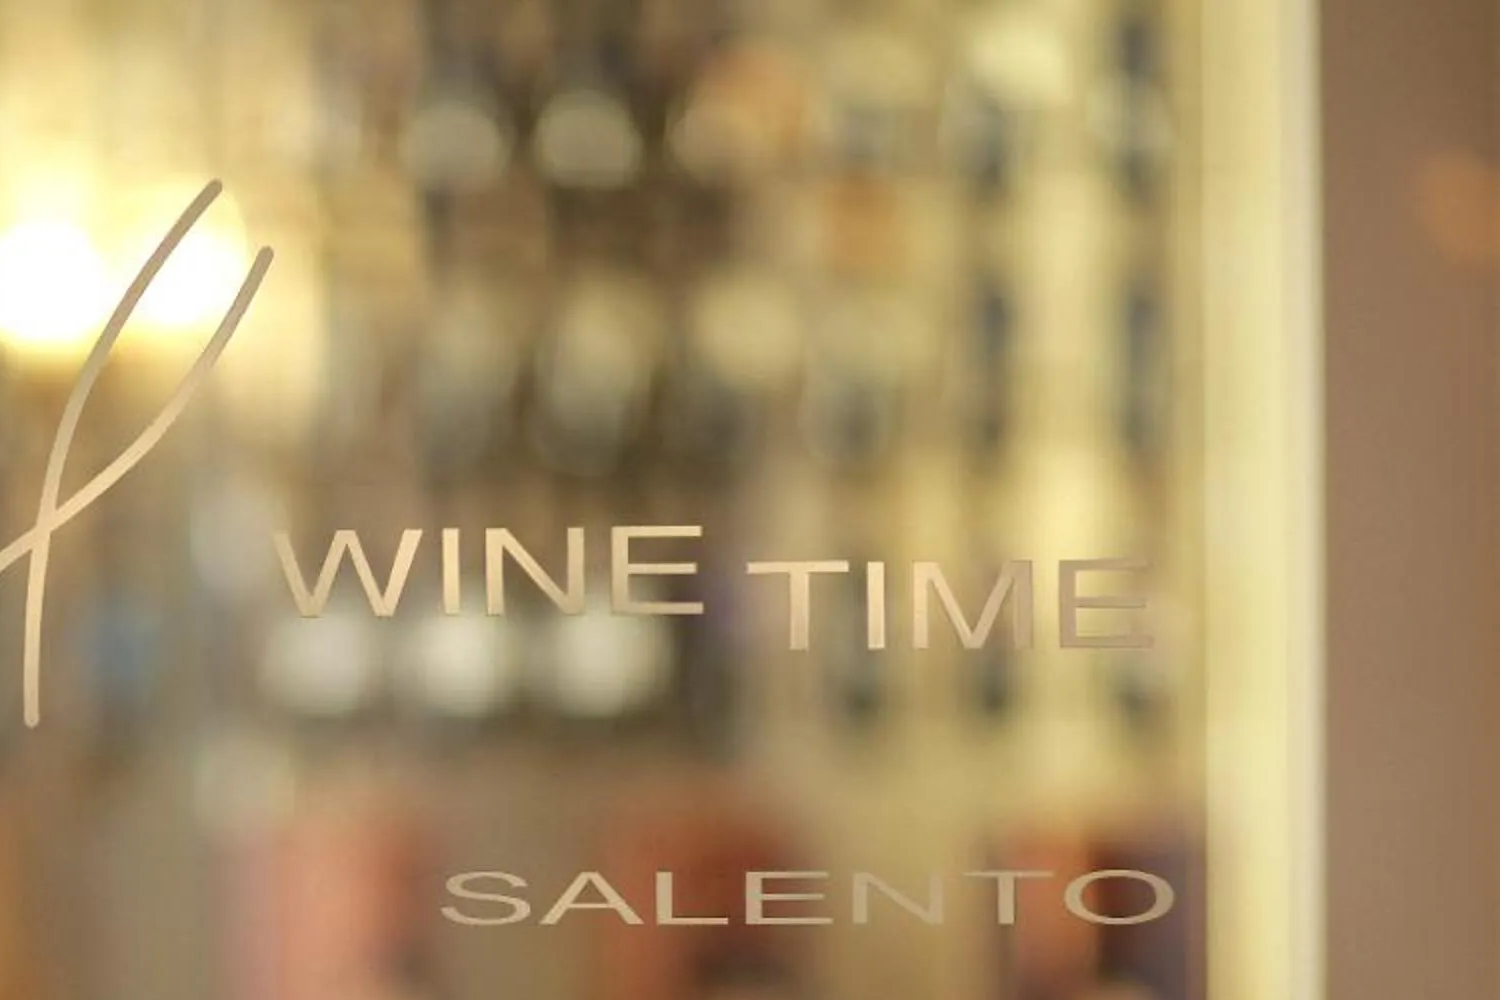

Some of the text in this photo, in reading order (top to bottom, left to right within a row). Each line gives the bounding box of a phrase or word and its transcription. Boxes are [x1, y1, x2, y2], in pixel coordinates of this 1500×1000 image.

[274, 525, 1155, 650] WINE TIME
[441, 869, 1175, 926] SALENTO
